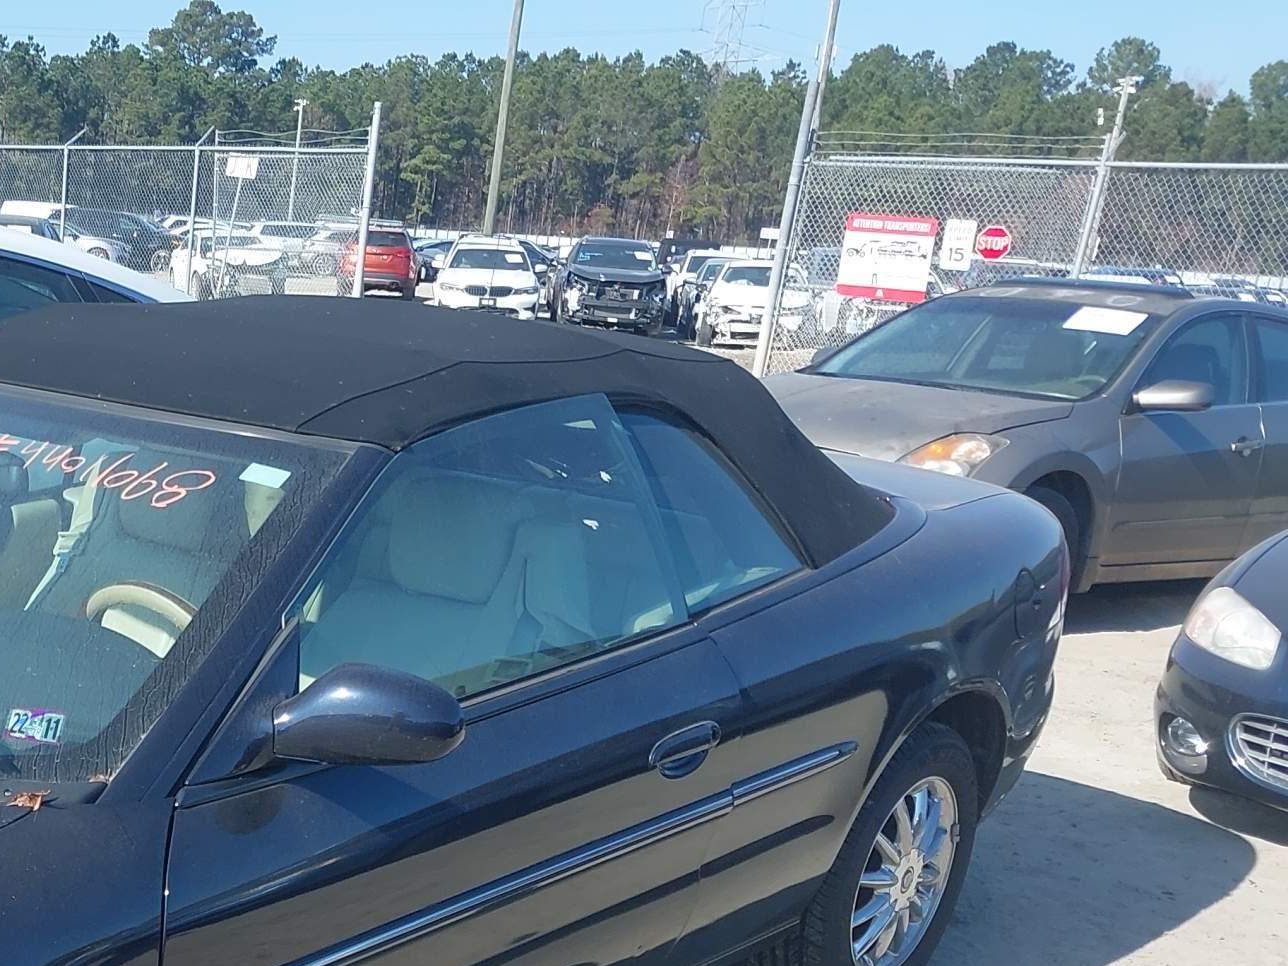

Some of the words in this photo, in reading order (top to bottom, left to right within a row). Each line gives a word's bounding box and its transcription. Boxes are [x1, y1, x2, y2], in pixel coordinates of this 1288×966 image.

[978, 236, 1009, 250] STOP
[948, 247, 965, 262] 15
[9, 712, 29, 734] 22
[44, 718, 61, 740] 11
